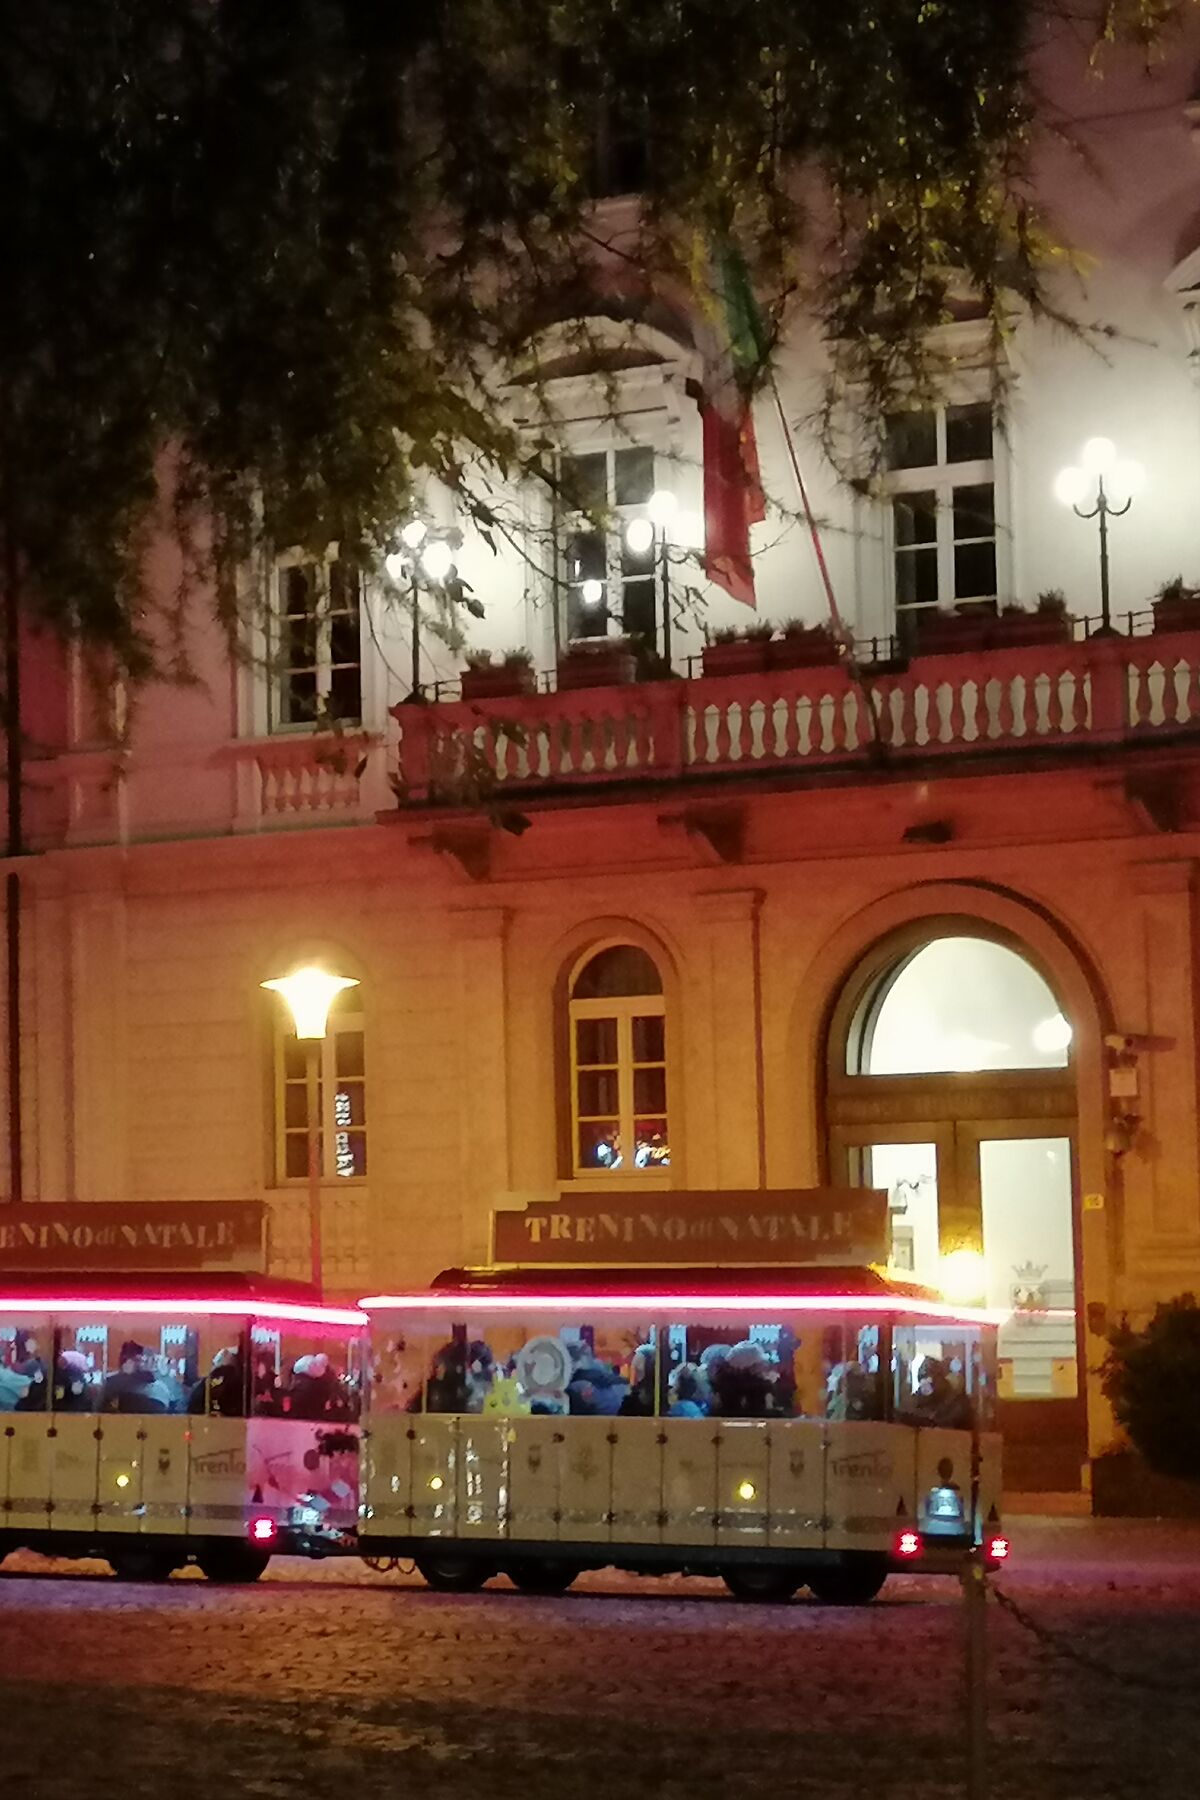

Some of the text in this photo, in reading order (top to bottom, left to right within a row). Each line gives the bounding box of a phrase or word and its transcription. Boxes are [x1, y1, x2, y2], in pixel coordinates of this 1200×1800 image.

[120, 1221, 236, 1248] NATALE
[525, 1213, 688, 1243] TRENINO
[717, 1211, 854, 1241] NATALE
